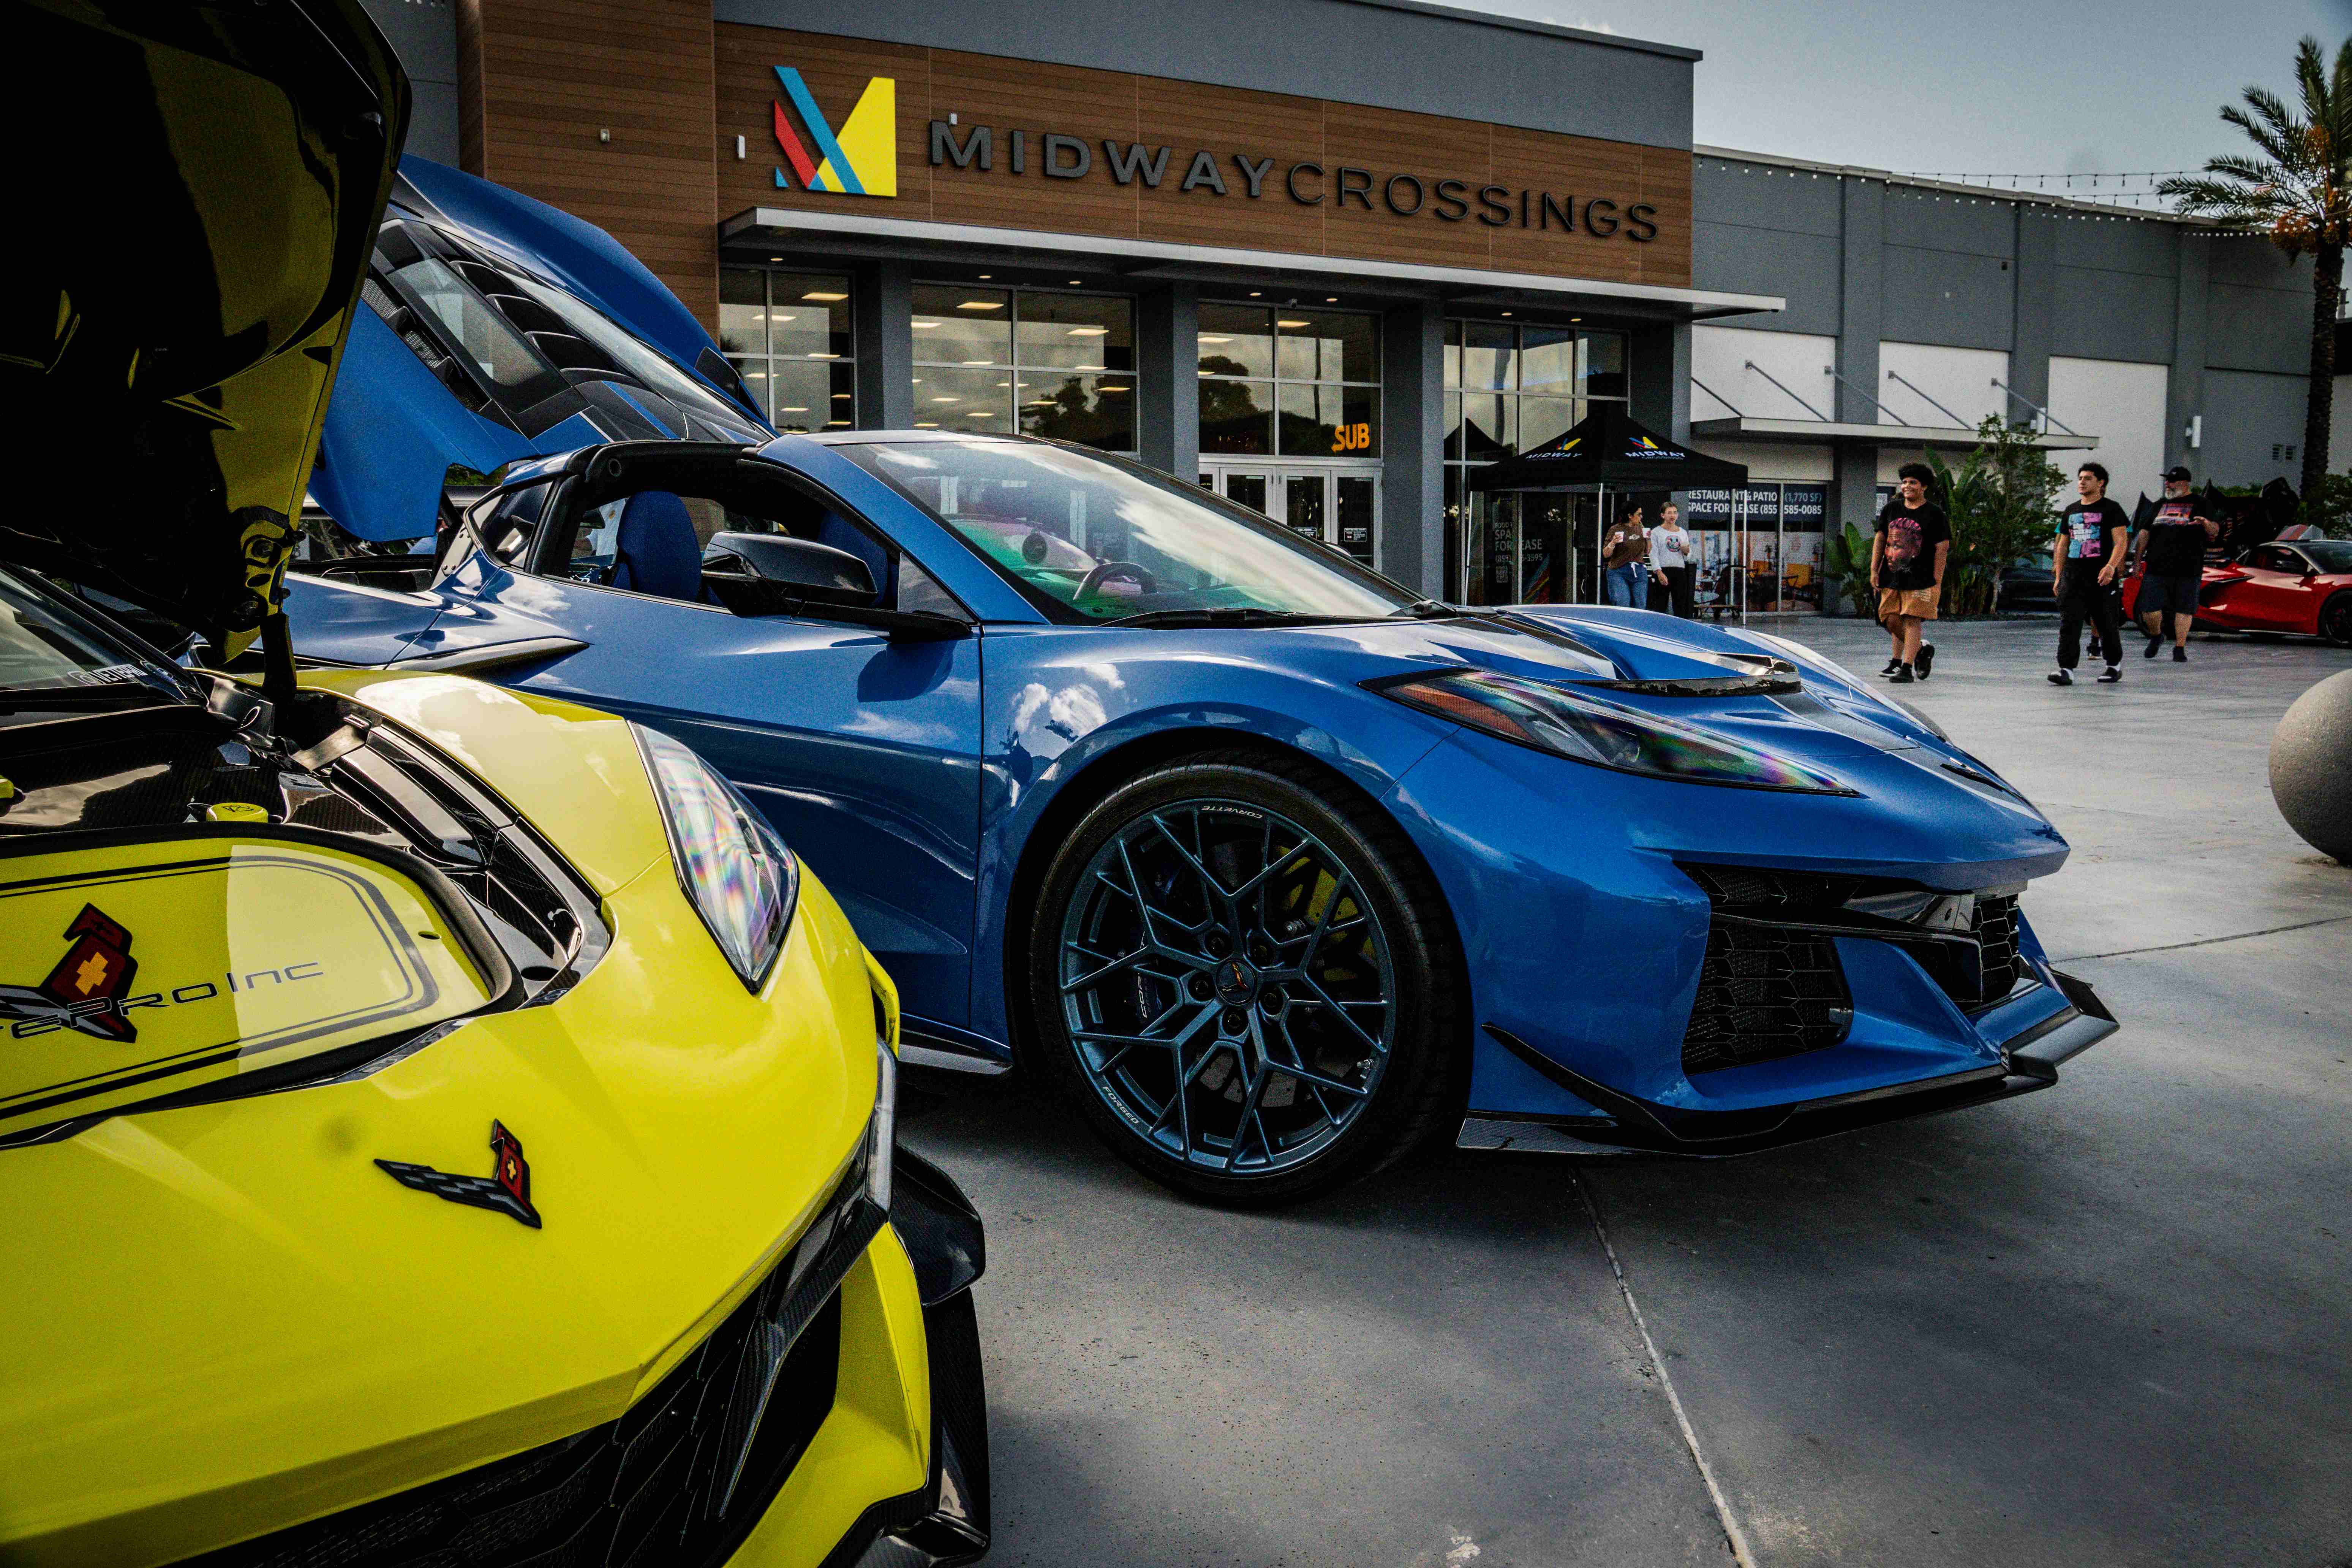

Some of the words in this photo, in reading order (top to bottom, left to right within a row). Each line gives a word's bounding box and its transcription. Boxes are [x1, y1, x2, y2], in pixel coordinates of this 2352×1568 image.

[1331, 423, 1370, 452] SUB
[1753, 492, 1777, 501] PATIO
[1713, 503, 1729, 513] FOR
[1784, 504, 1822, 515] 585-0085
[1201, 806, 1263, 819] CORVETTE
[1103, 1086, 1139, 1124] FORGED
